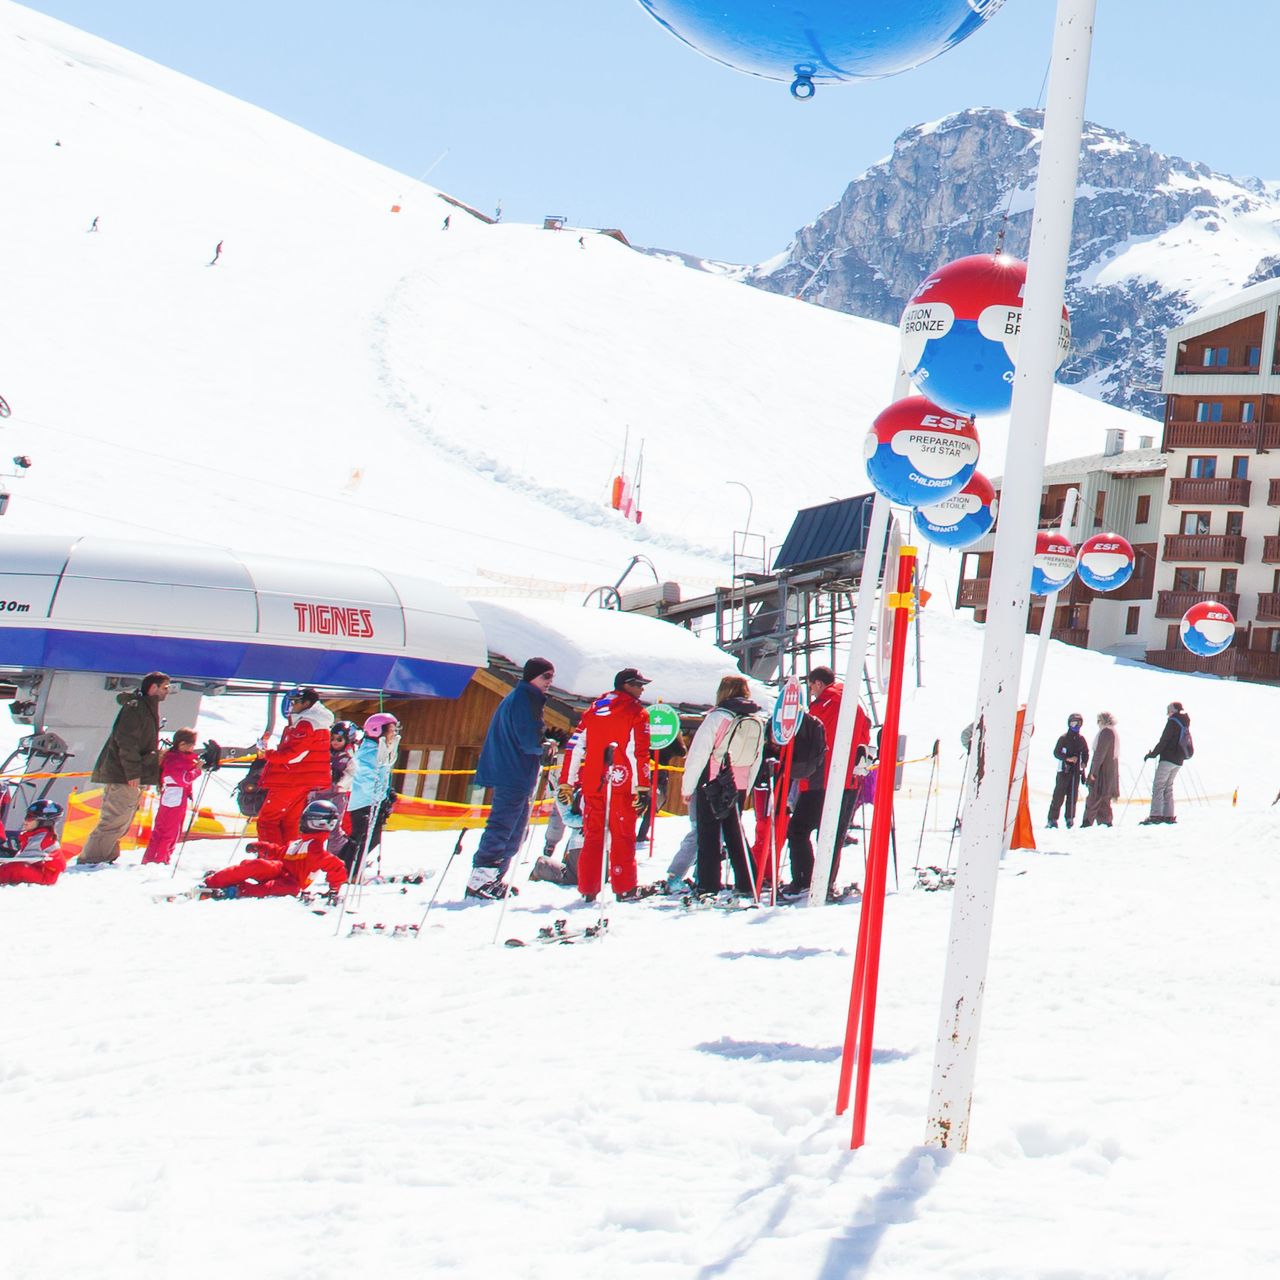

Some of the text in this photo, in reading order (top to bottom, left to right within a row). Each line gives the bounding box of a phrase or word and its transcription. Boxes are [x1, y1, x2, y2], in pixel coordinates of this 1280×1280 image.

[920, 415, 969, 431] ESF
[909, 435, 971, 451] PREPARATION
[921, 445, 961, 457] 3rd STAR
[908, 472, 953, 488] CHILDREN
[1047, 544, 1071, 554] ESF
[1093, 543, 1120, 551] ESF
[293, 602, 374, 638] TIGNES
